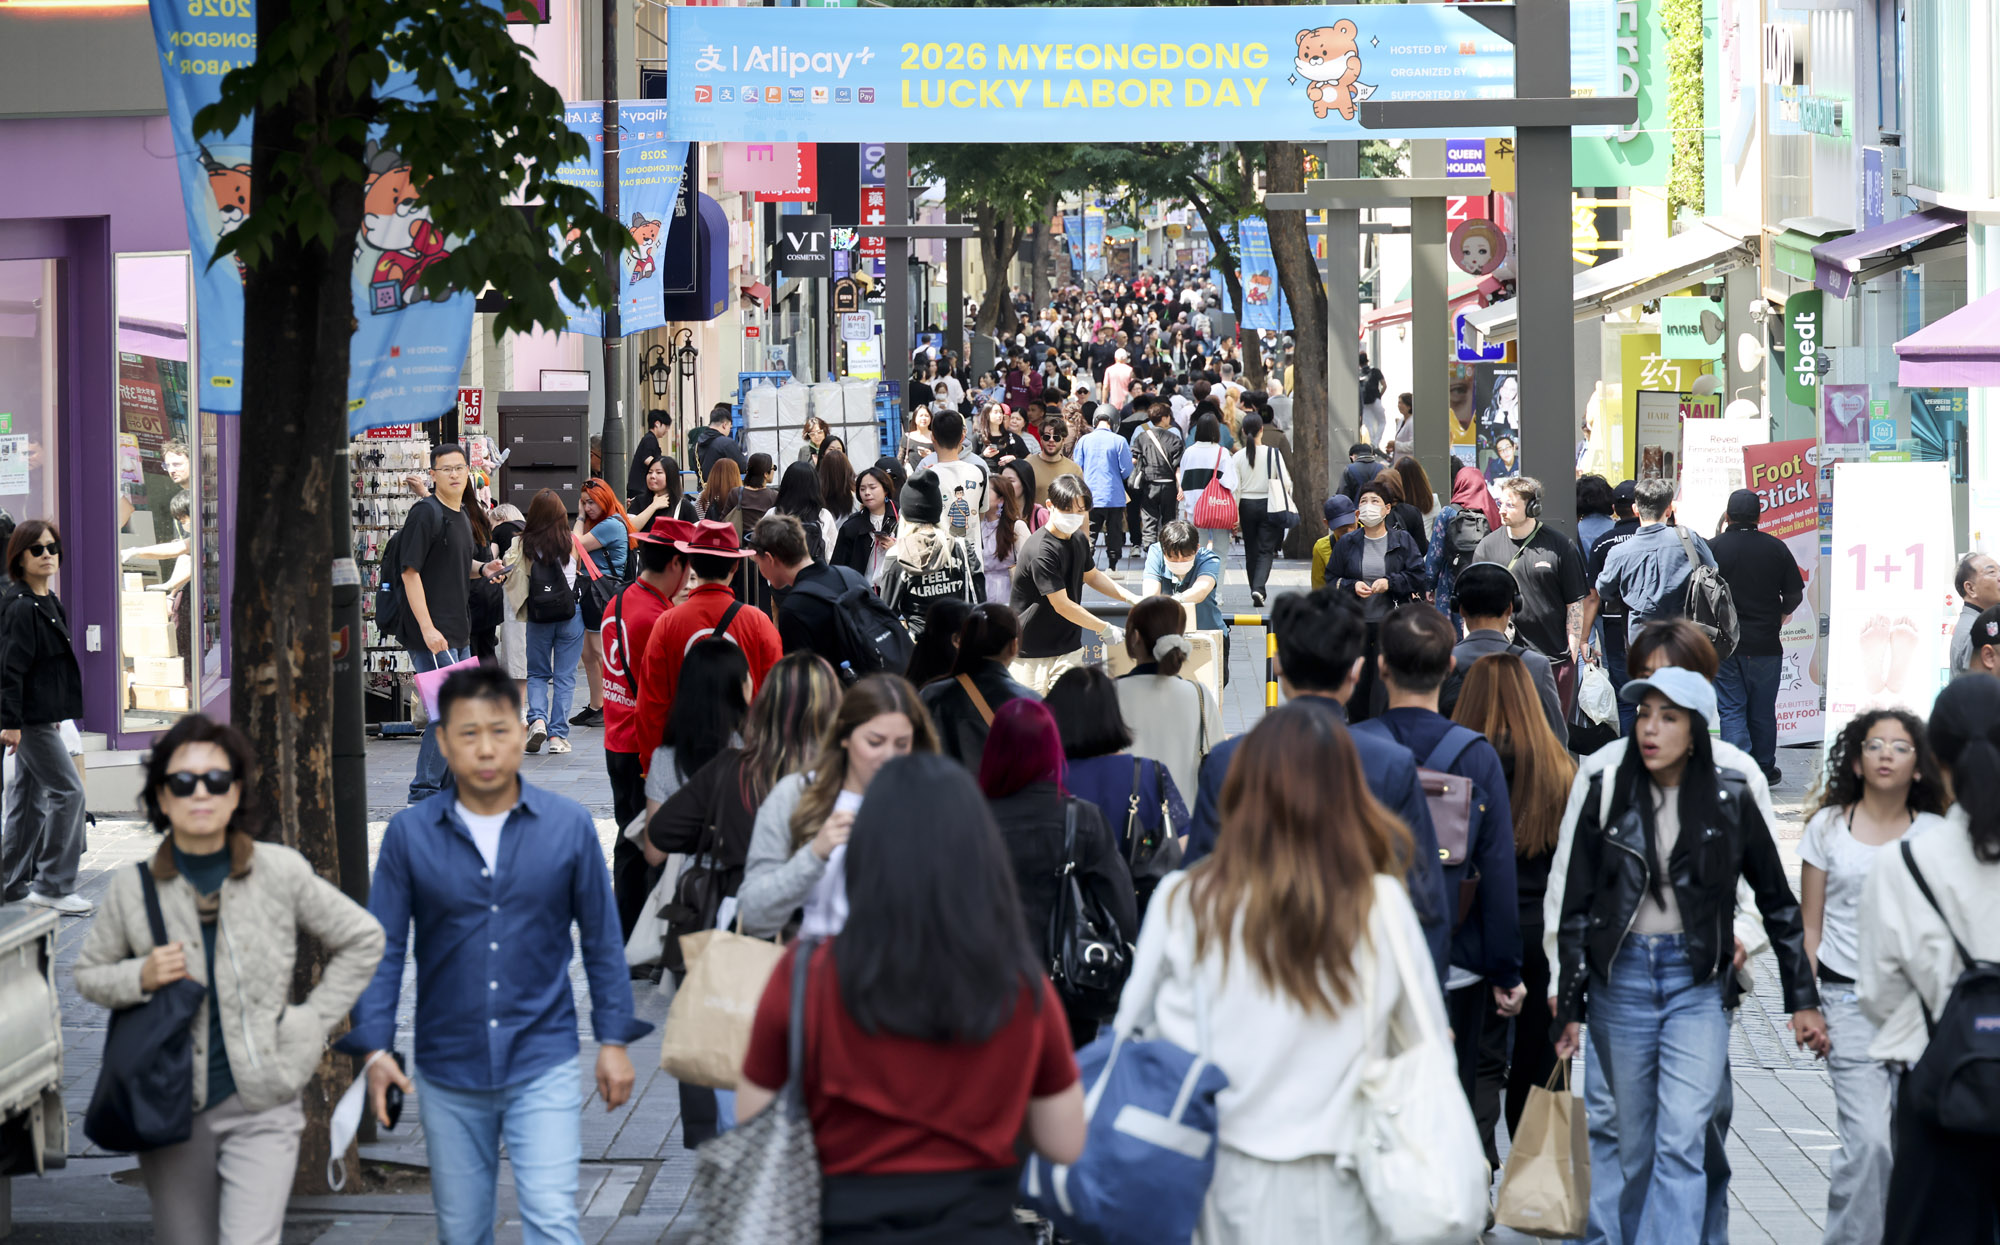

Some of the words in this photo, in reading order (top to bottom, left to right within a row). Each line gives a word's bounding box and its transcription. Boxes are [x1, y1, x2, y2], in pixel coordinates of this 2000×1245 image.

[900, 42, 987, 70] 2026
[997, 41, 1269, 70] MYEONGDONG
[1390, 45, 1432, 55] HOSTED
[1434, 45, 1448, 54] BY
[1390, 67, 1452, 77] ORGANIZED
[1453, 66, 1467, 77] BY
[901, 79, 1032, 108] LUCKY
[1042, 78, 1173, 108] LABOR
[1184, 77, 1269, 107] DAY
[1390, 90, 1452, 100] SUPPORTED
[1453, 89, 1467, 100] BY
[1448, 149, 1482, 160] QUEEN
[1446, 163, 1486, 173] HOLIDAY
[786, 231, 825, 251] VT
[1793, 312, 1816, 386] sbedt
[1952, 397, 1963, 412] 3
[1647, 412, 1669, 420] HAIR
[1710, 435, 1739, 443] Reveal
[1752, 455, 1803, 488] Foot
[1756, 479, 1812, 513] Stick
[1779, 525, 1793, 535] clean
[1793, 520, 1804, 530] like
[1805, 518, 1815, 527] the
[1847, 543, 1924, 590] 1+1
[921, 571, 949, 585] FEEL
[910, 580, 963, 597] ALRIGHT?
[1788, 700, 1814, 709] BUTTER
[1834, 704, 1854, 712] After
[1796, 708, 1820, 719] FOOT
